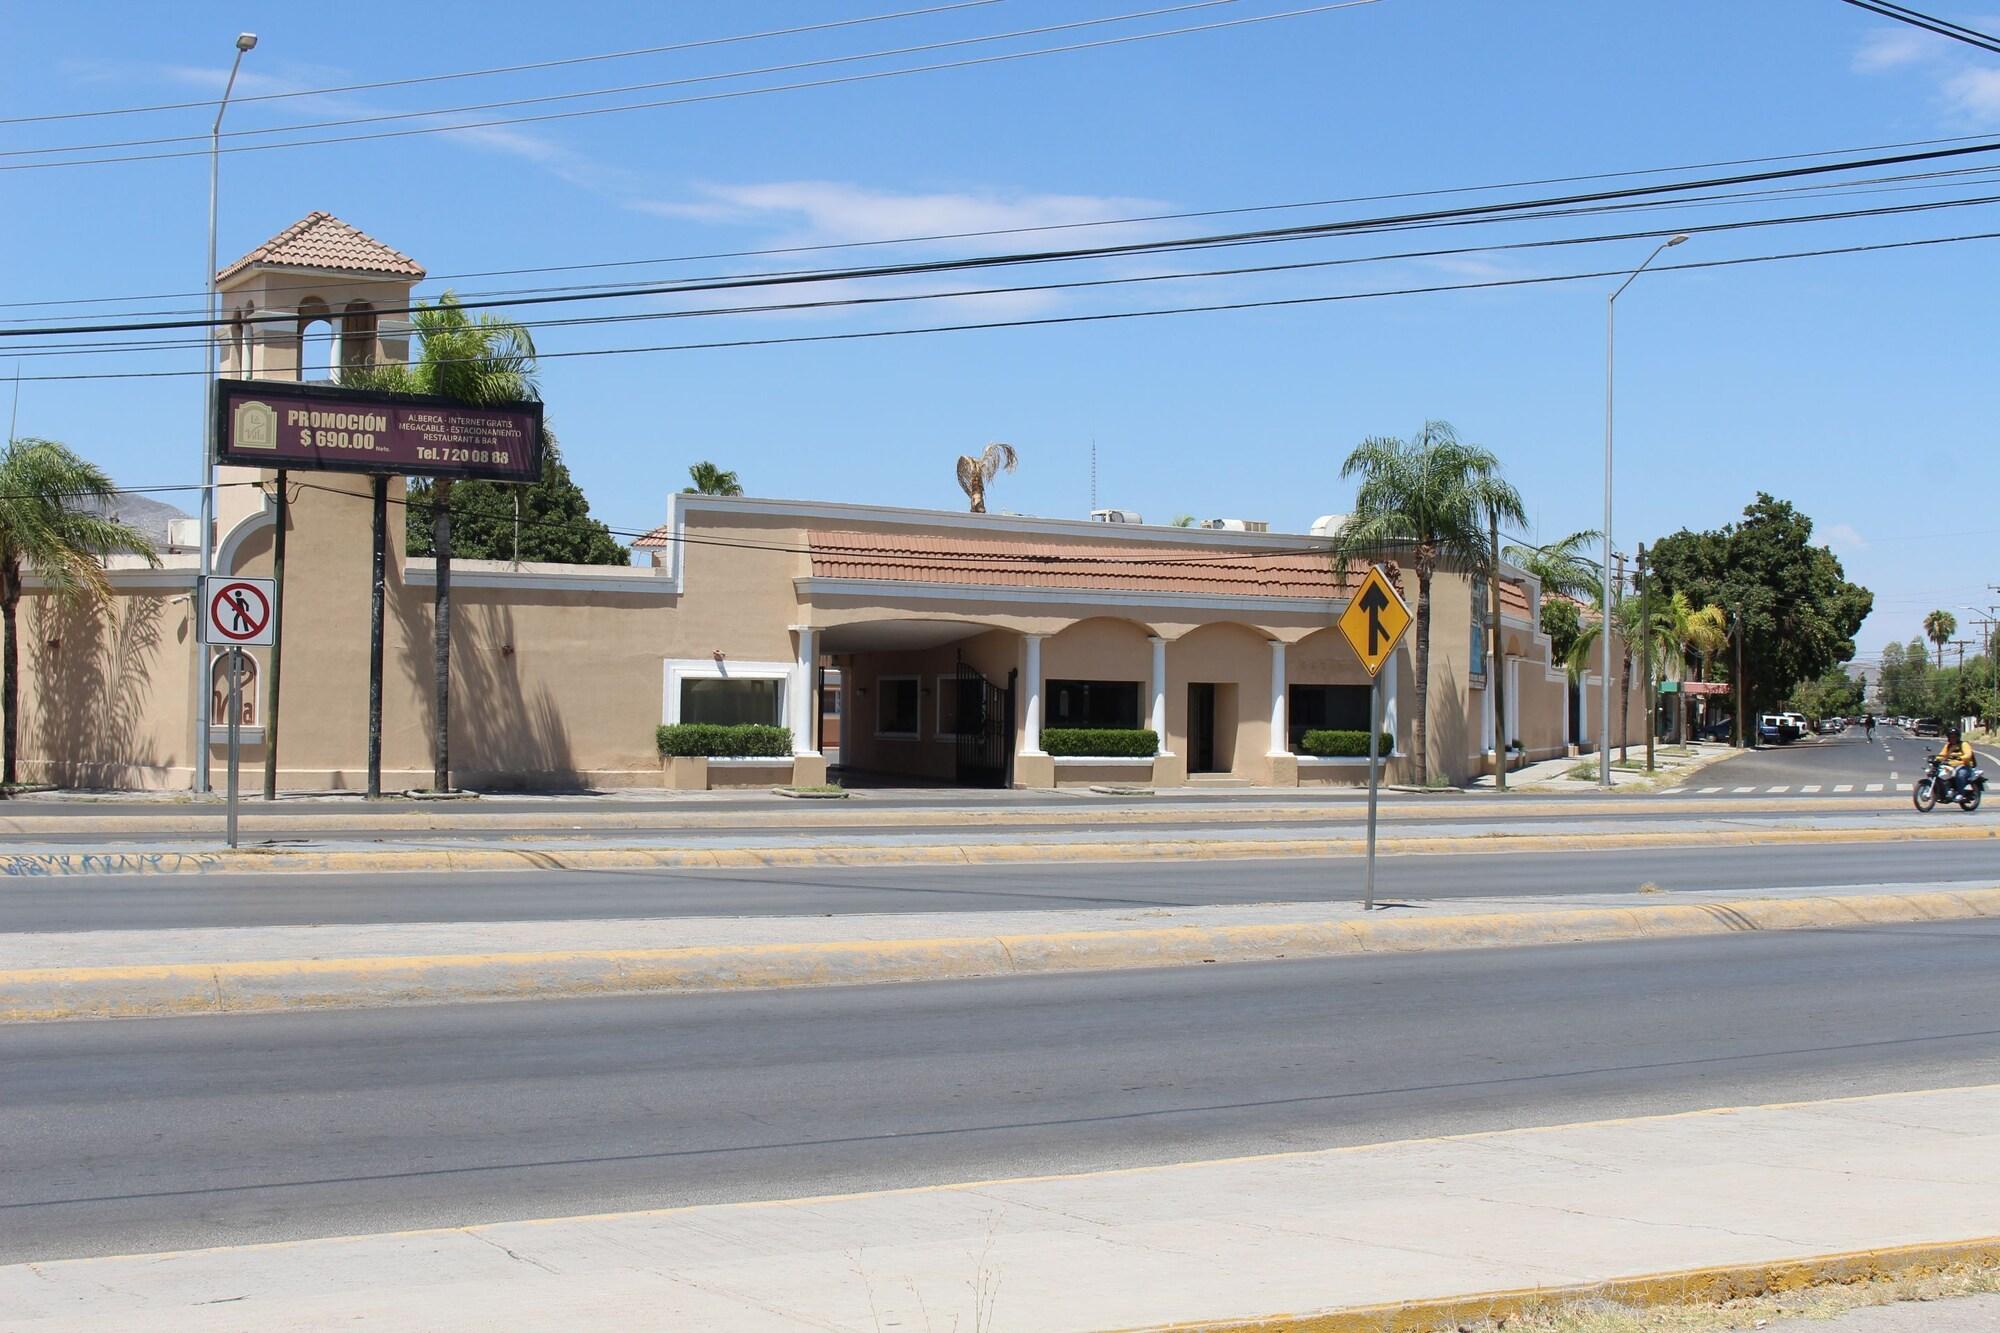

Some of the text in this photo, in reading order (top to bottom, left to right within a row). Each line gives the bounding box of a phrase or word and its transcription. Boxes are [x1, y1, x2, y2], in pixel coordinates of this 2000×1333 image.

[288, 410, 387, 432] PROMOCIÓN
[408, 414, 443, 424] ALBERCA
[448, 417, 485, 426] INTERNET
[399, 422, 445, 433] MEGACABLE
[450, 426, 521, 437] ESTACIONAMIENTO
[300, 429, 311, 447] $
[315, 430, 375, 450] 690.00
[423, 433, 473, 444] RESTAURANT
[482, 437, 497, 445] BAR
[416, 446, 440, 460] Tel.
[471, 450, 489, 463] 08
[491, 451, 509, 464] 88
